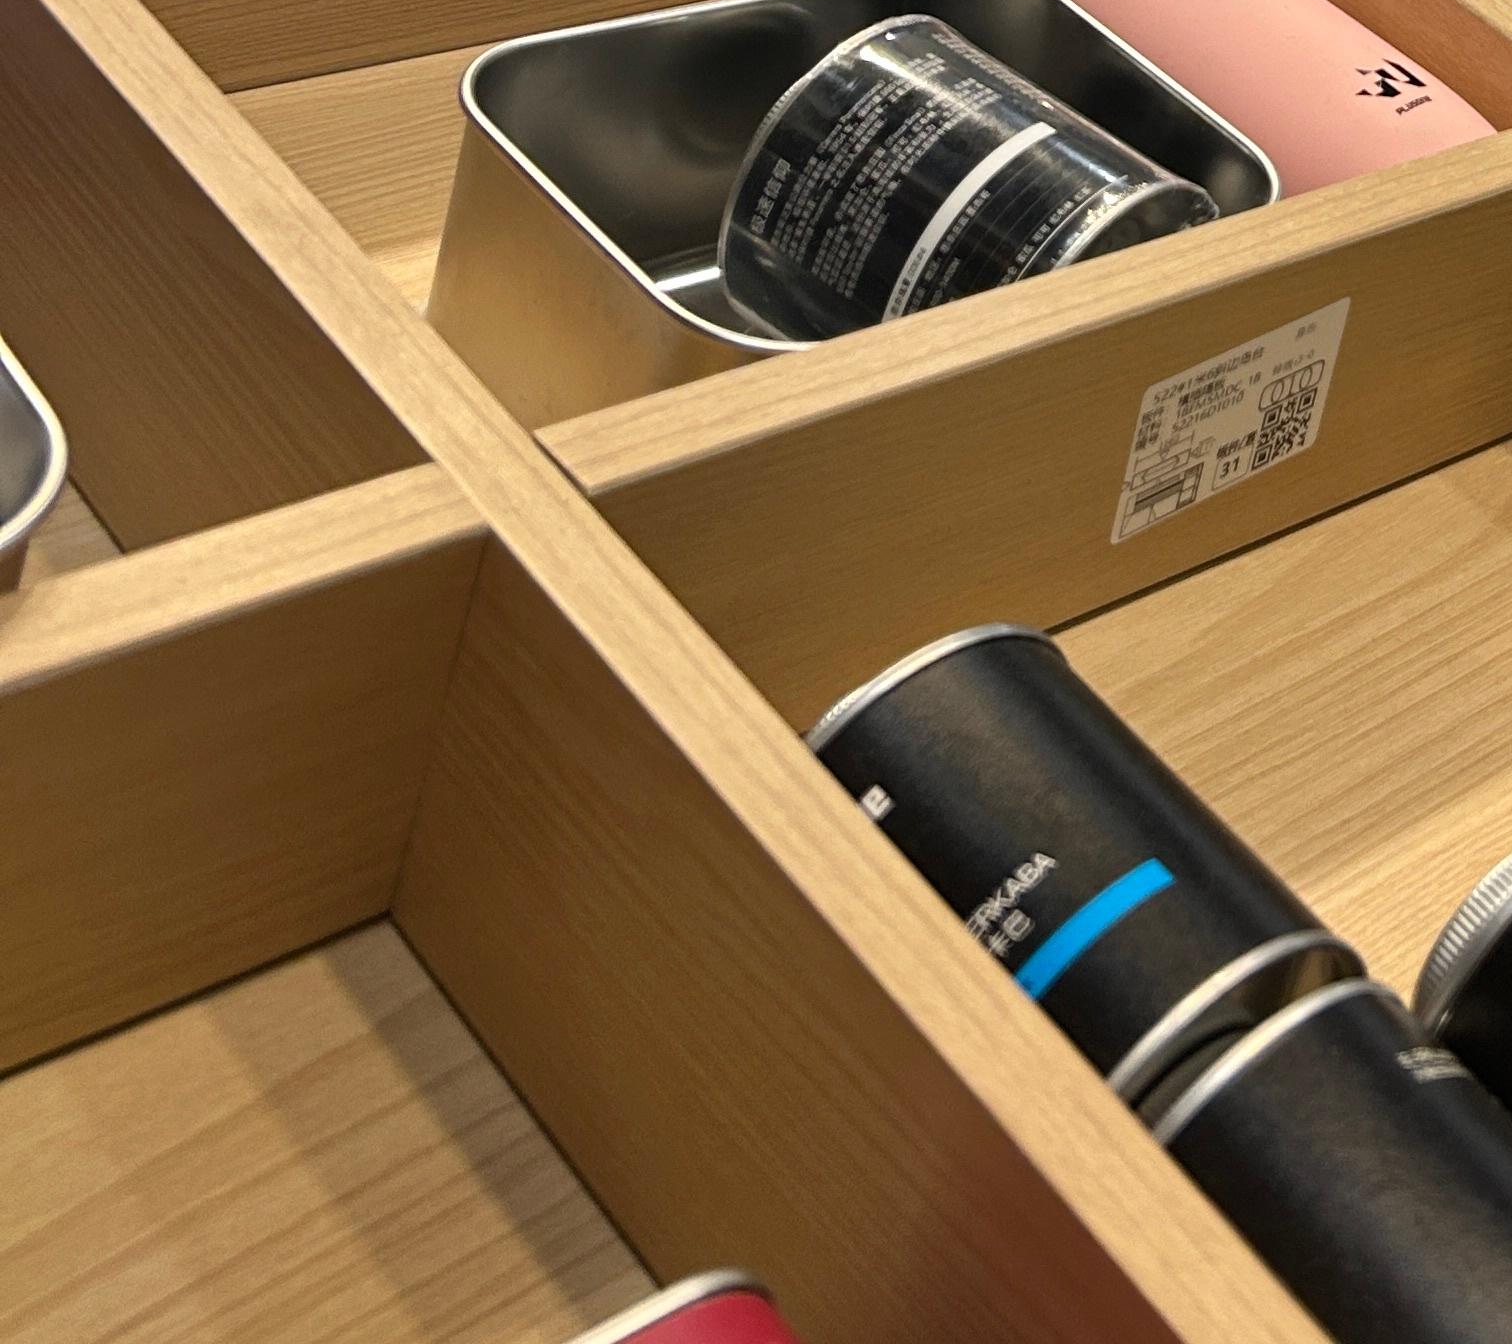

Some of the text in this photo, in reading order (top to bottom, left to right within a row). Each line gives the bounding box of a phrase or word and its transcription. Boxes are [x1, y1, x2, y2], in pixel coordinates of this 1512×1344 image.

[751, 157, 792, 234] 极速信仰
[1219, 458, 1241, 480] 31
